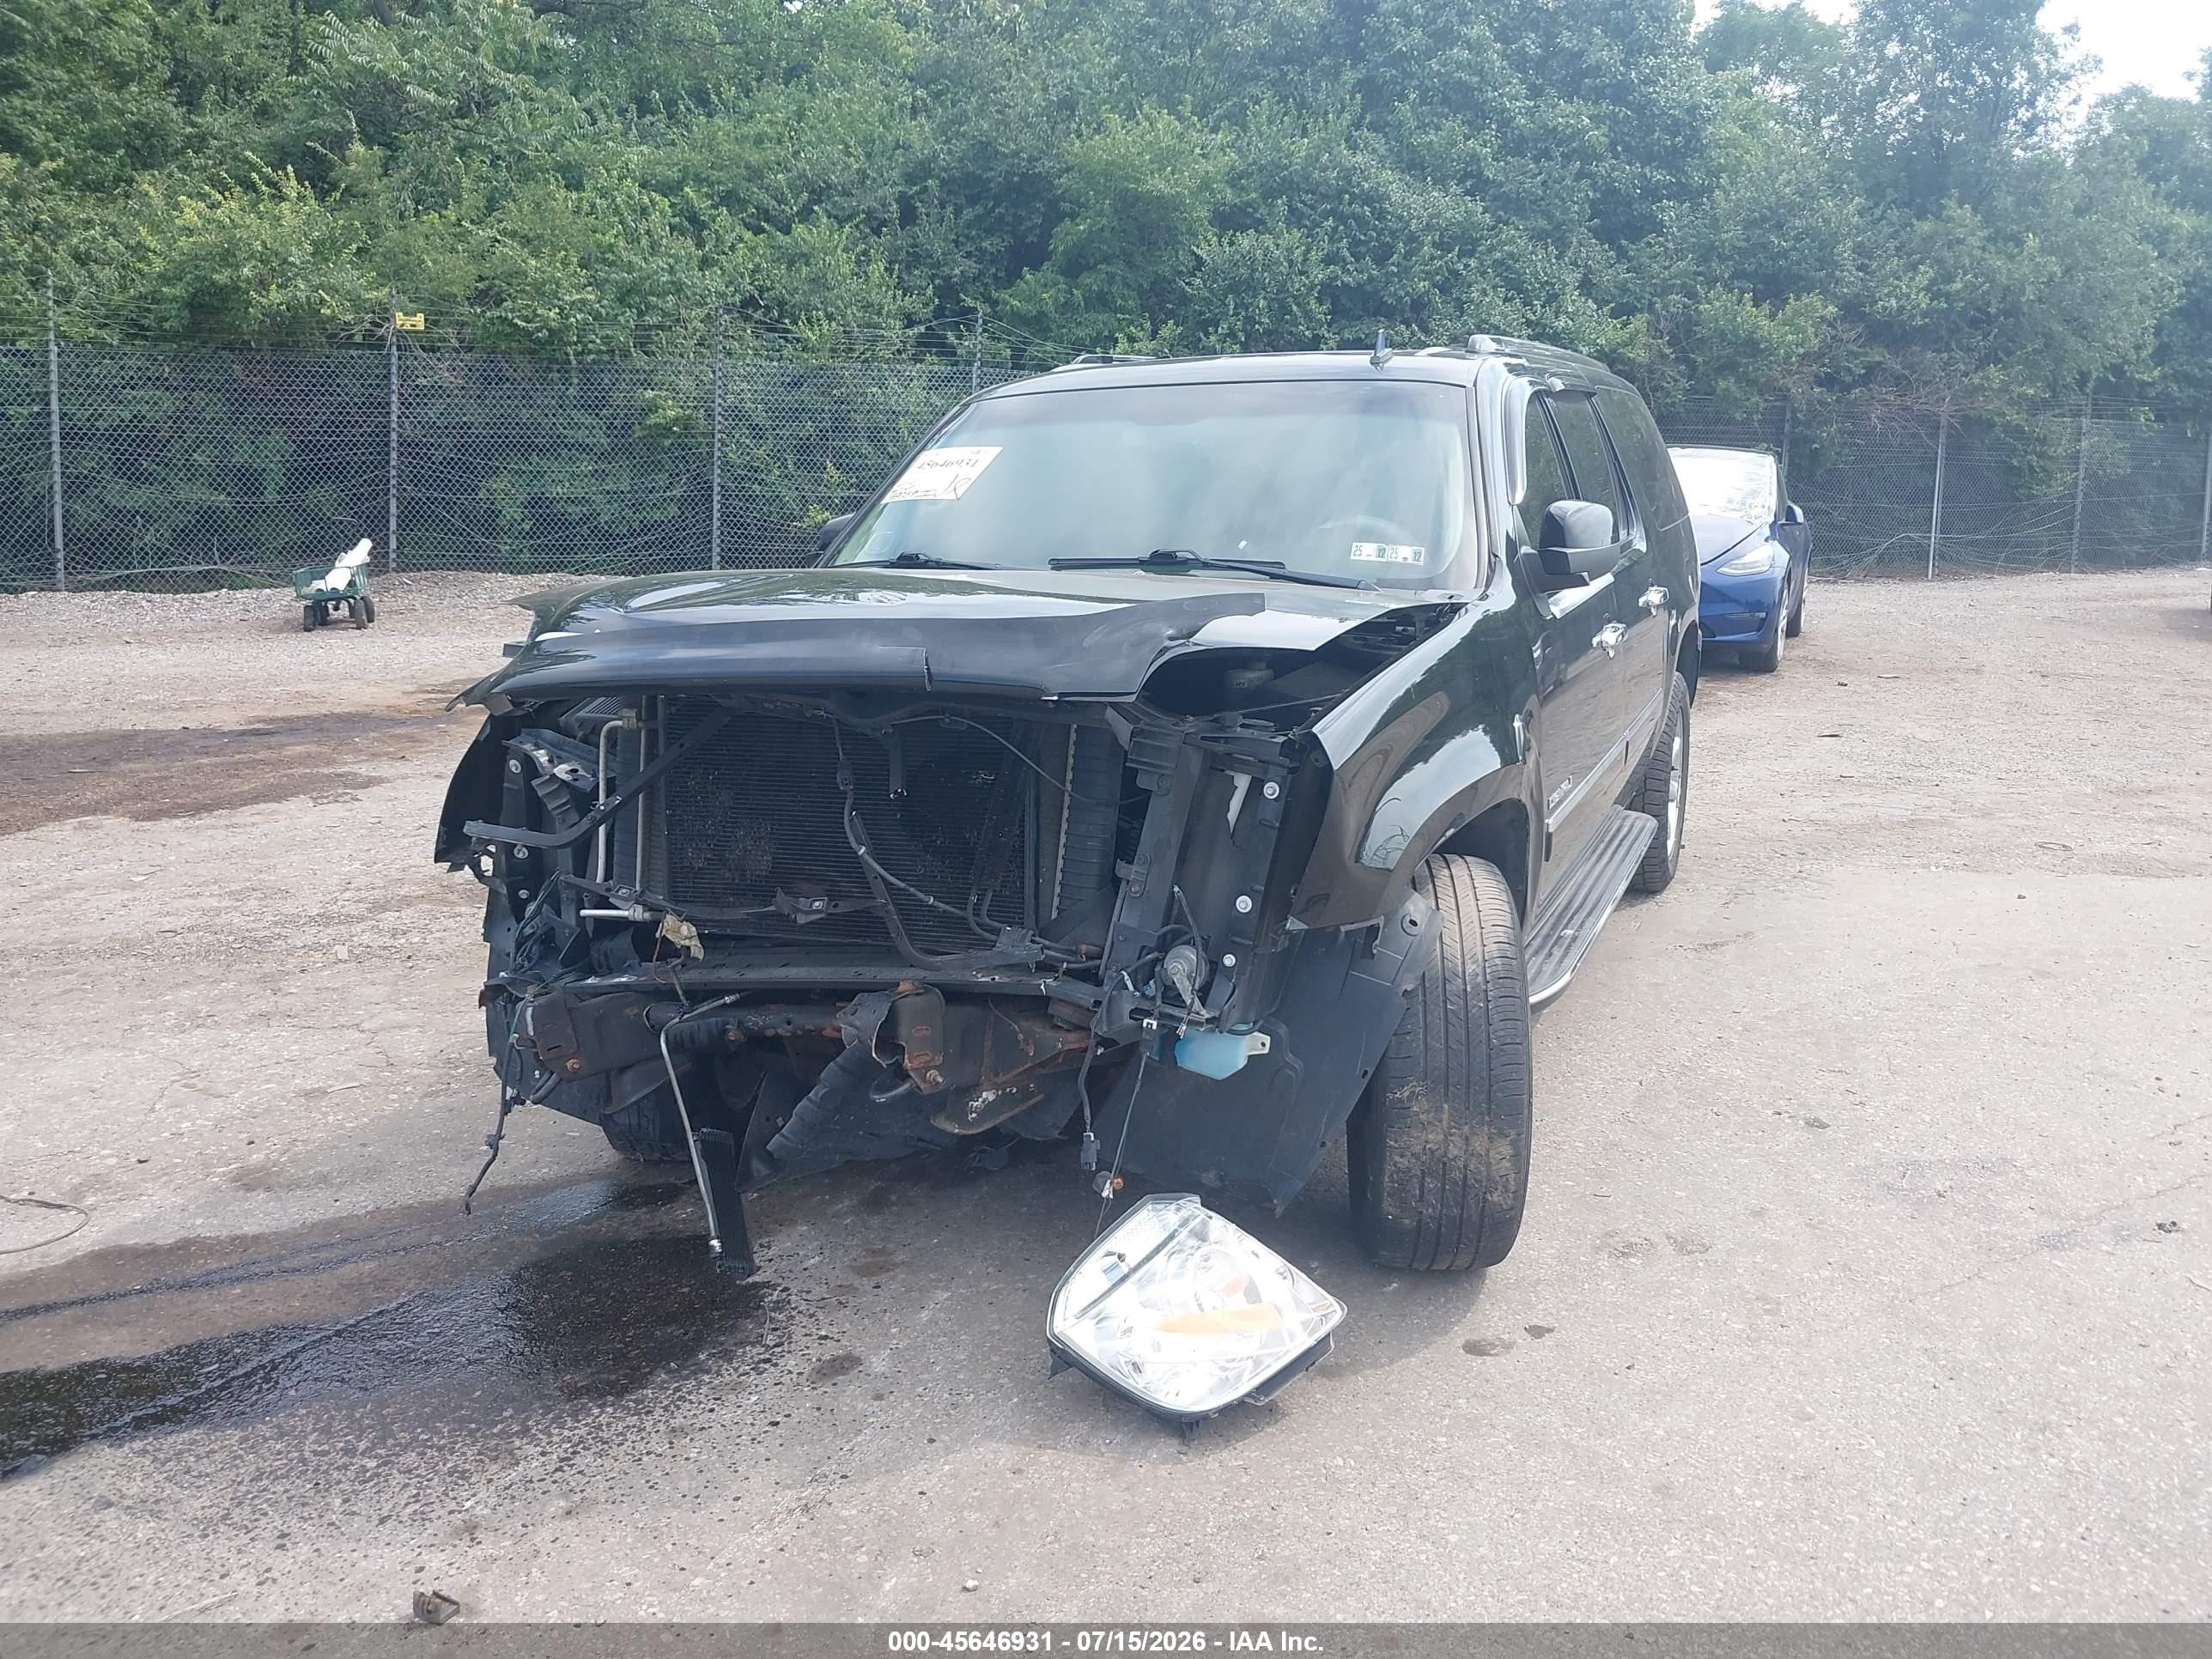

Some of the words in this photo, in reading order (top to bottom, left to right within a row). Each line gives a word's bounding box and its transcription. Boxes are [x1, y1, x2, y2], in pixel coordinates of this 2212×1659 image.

[1353, 544, 1363, 557] 25
[1377, 548, 1386, 558] 12
[1389, 547, 1399, 560] 25
[1413, 551, 1422, 562] 12
